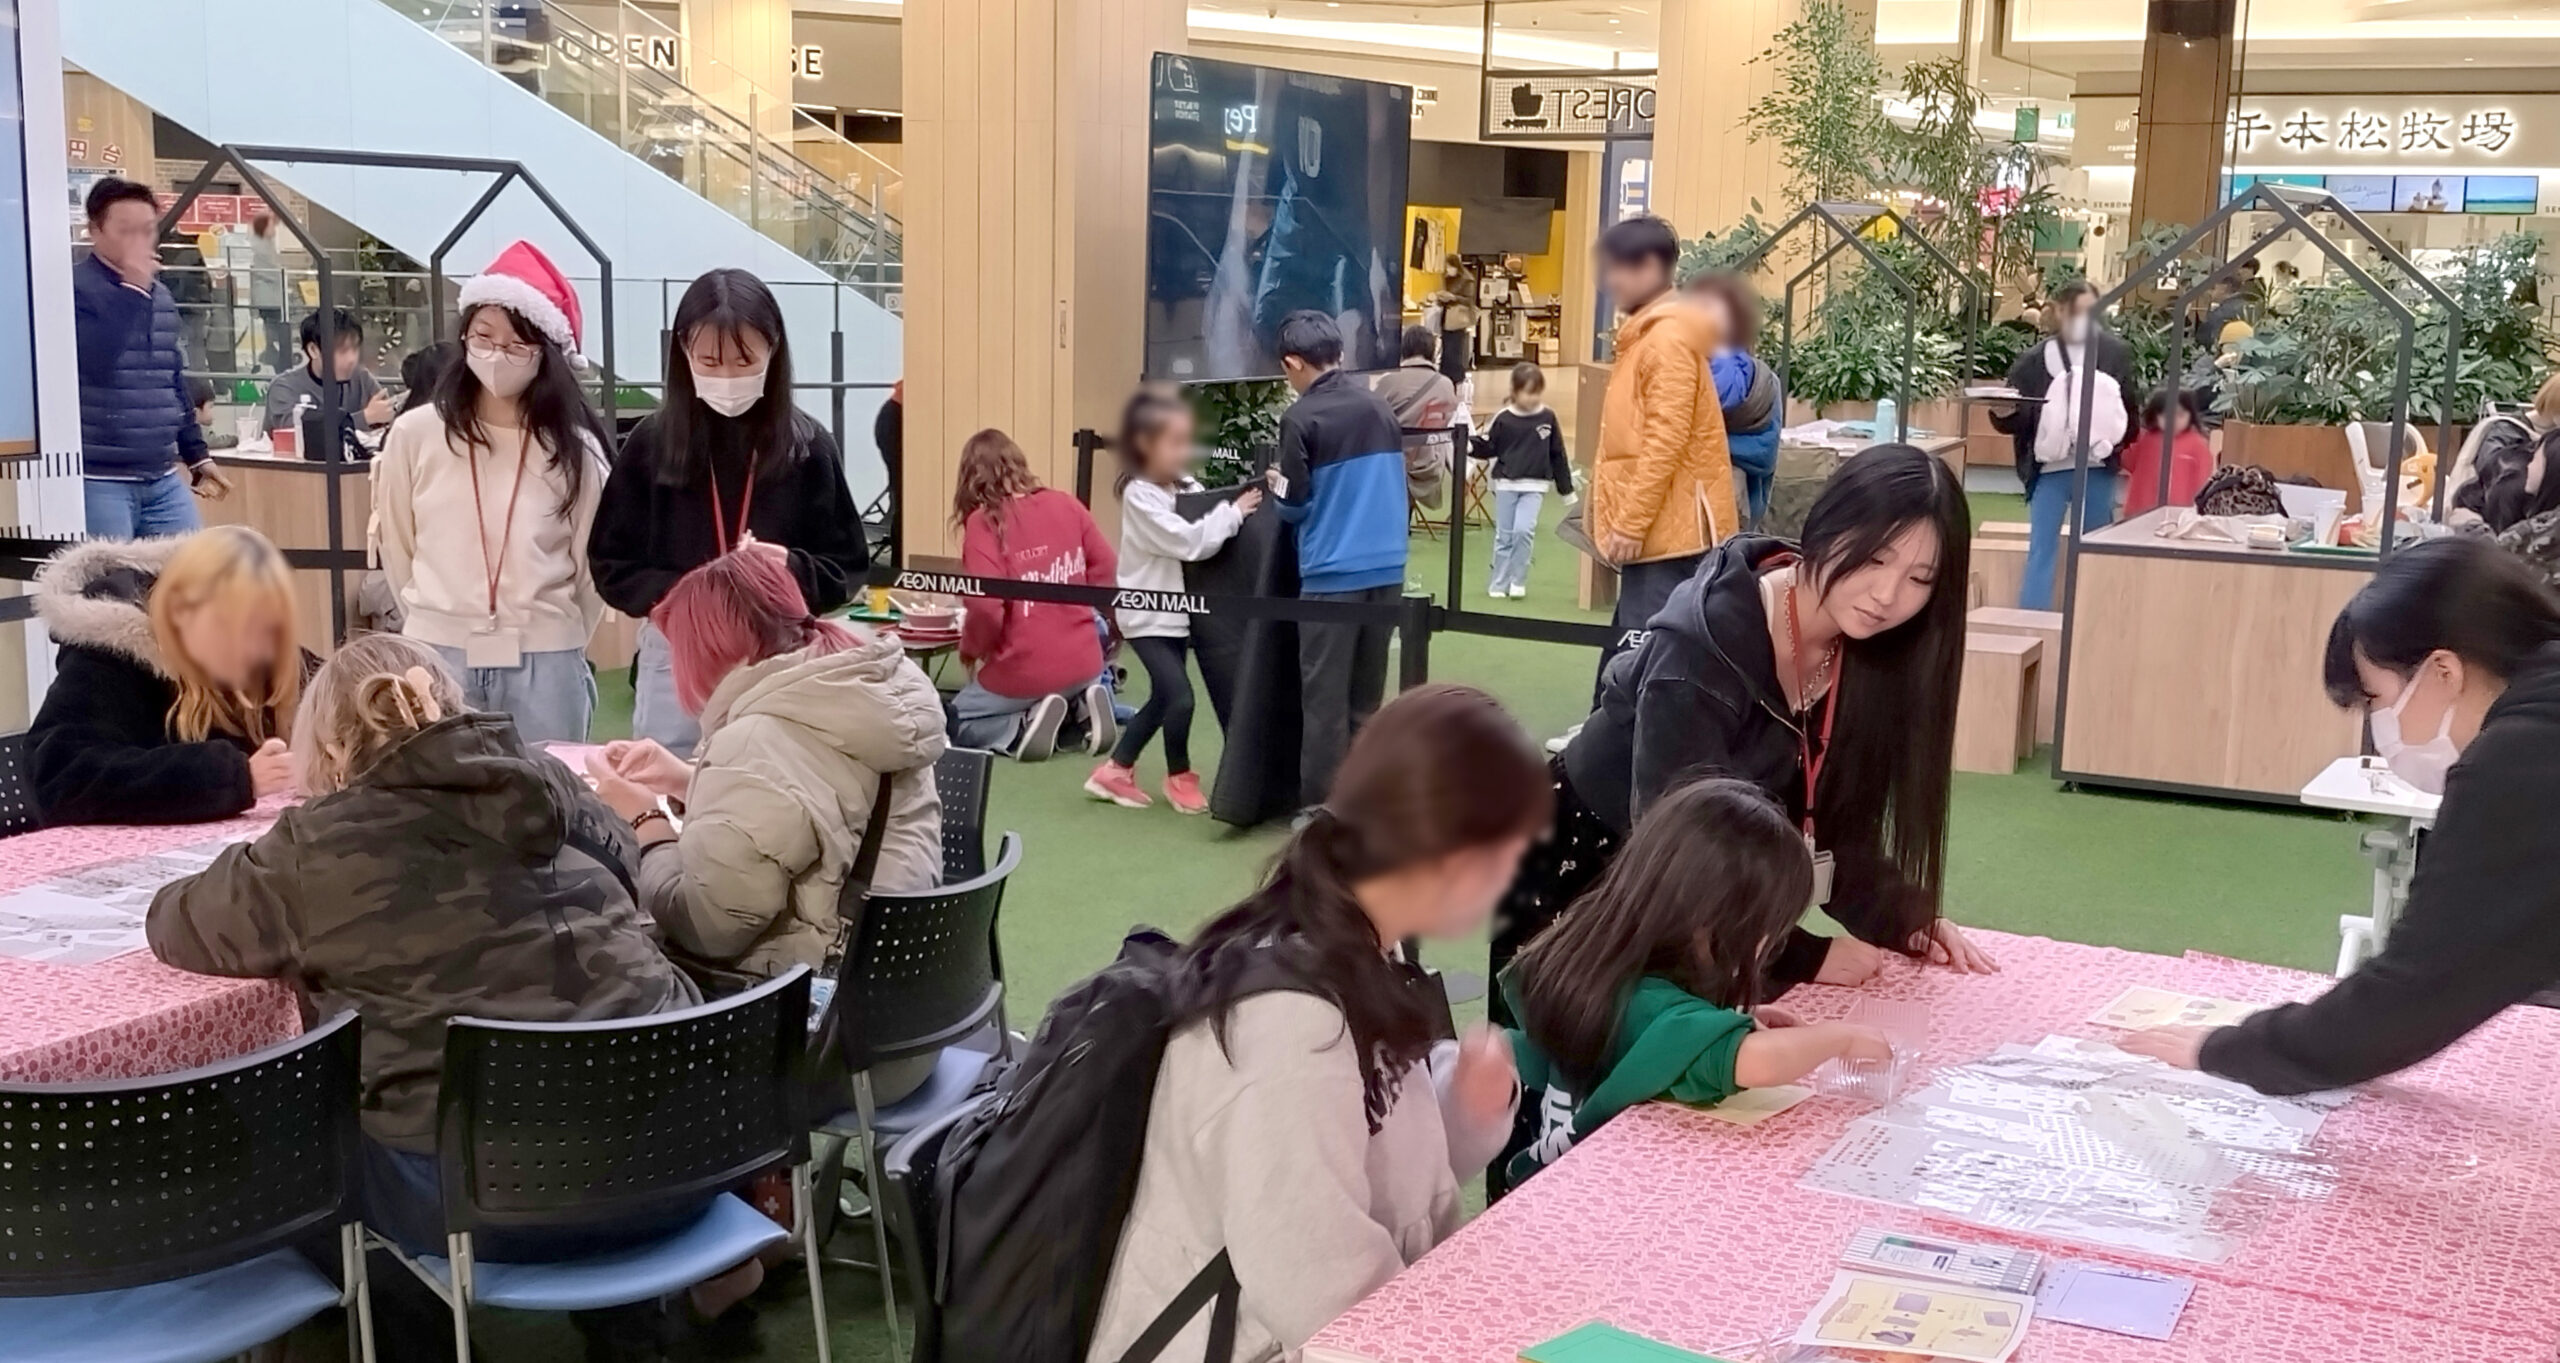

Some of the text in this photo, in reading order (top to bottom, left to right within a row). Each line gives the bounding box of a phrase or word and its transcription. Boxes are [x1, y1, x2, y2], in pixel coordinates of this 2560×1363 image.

[1212, 447, 1241, 460] MALL
[939, 576, 986, 596] MALL
[1161, 594, 1211, 614] MALL
